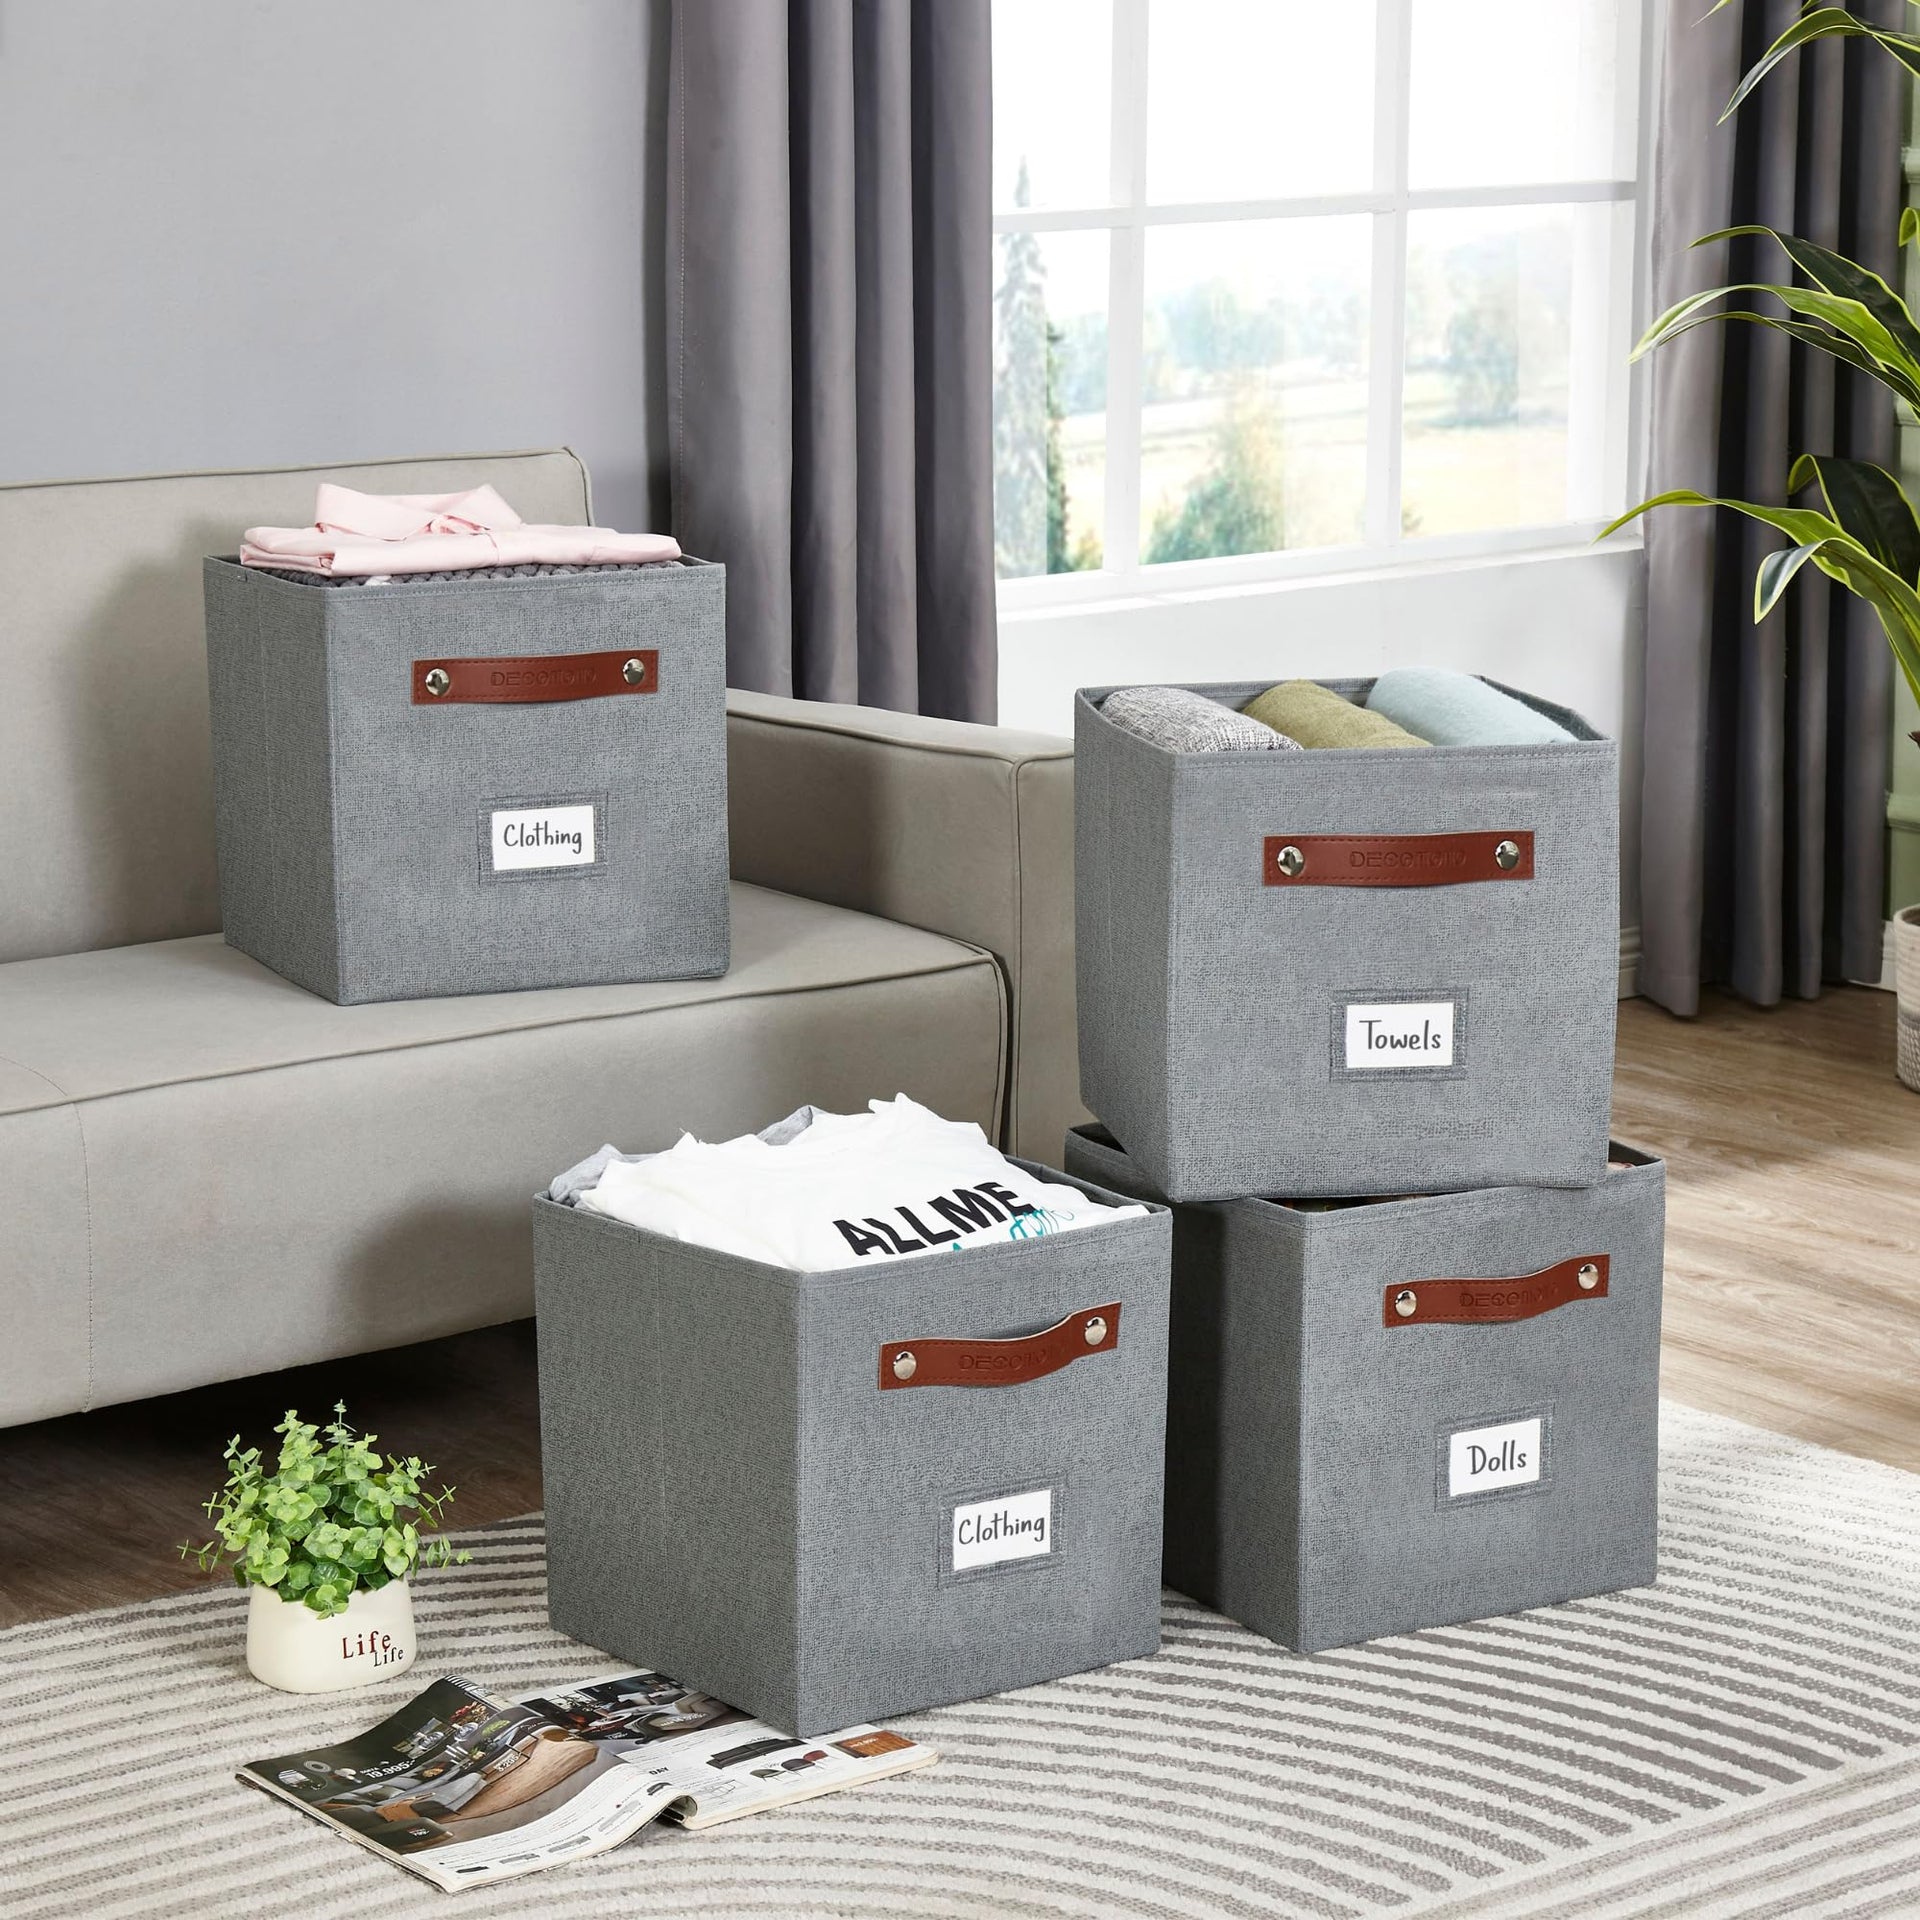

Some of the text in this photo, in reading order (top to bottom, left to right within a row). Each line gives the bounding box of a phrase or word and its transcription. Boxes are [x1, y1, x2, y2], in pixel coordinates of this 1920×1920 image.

[503, 821, 582, 855] Clothing
[1359, 1019, 1441, 1050] Towels
[832, 1181, 1036, 1256] ALLME
[1466, 1439, 1527, 1475] Dolls
[958, 1510, 1046, 1545] Clothing
[342, 1630, 391, 1659] Life
[373, 1647, 404, 1667] Life
